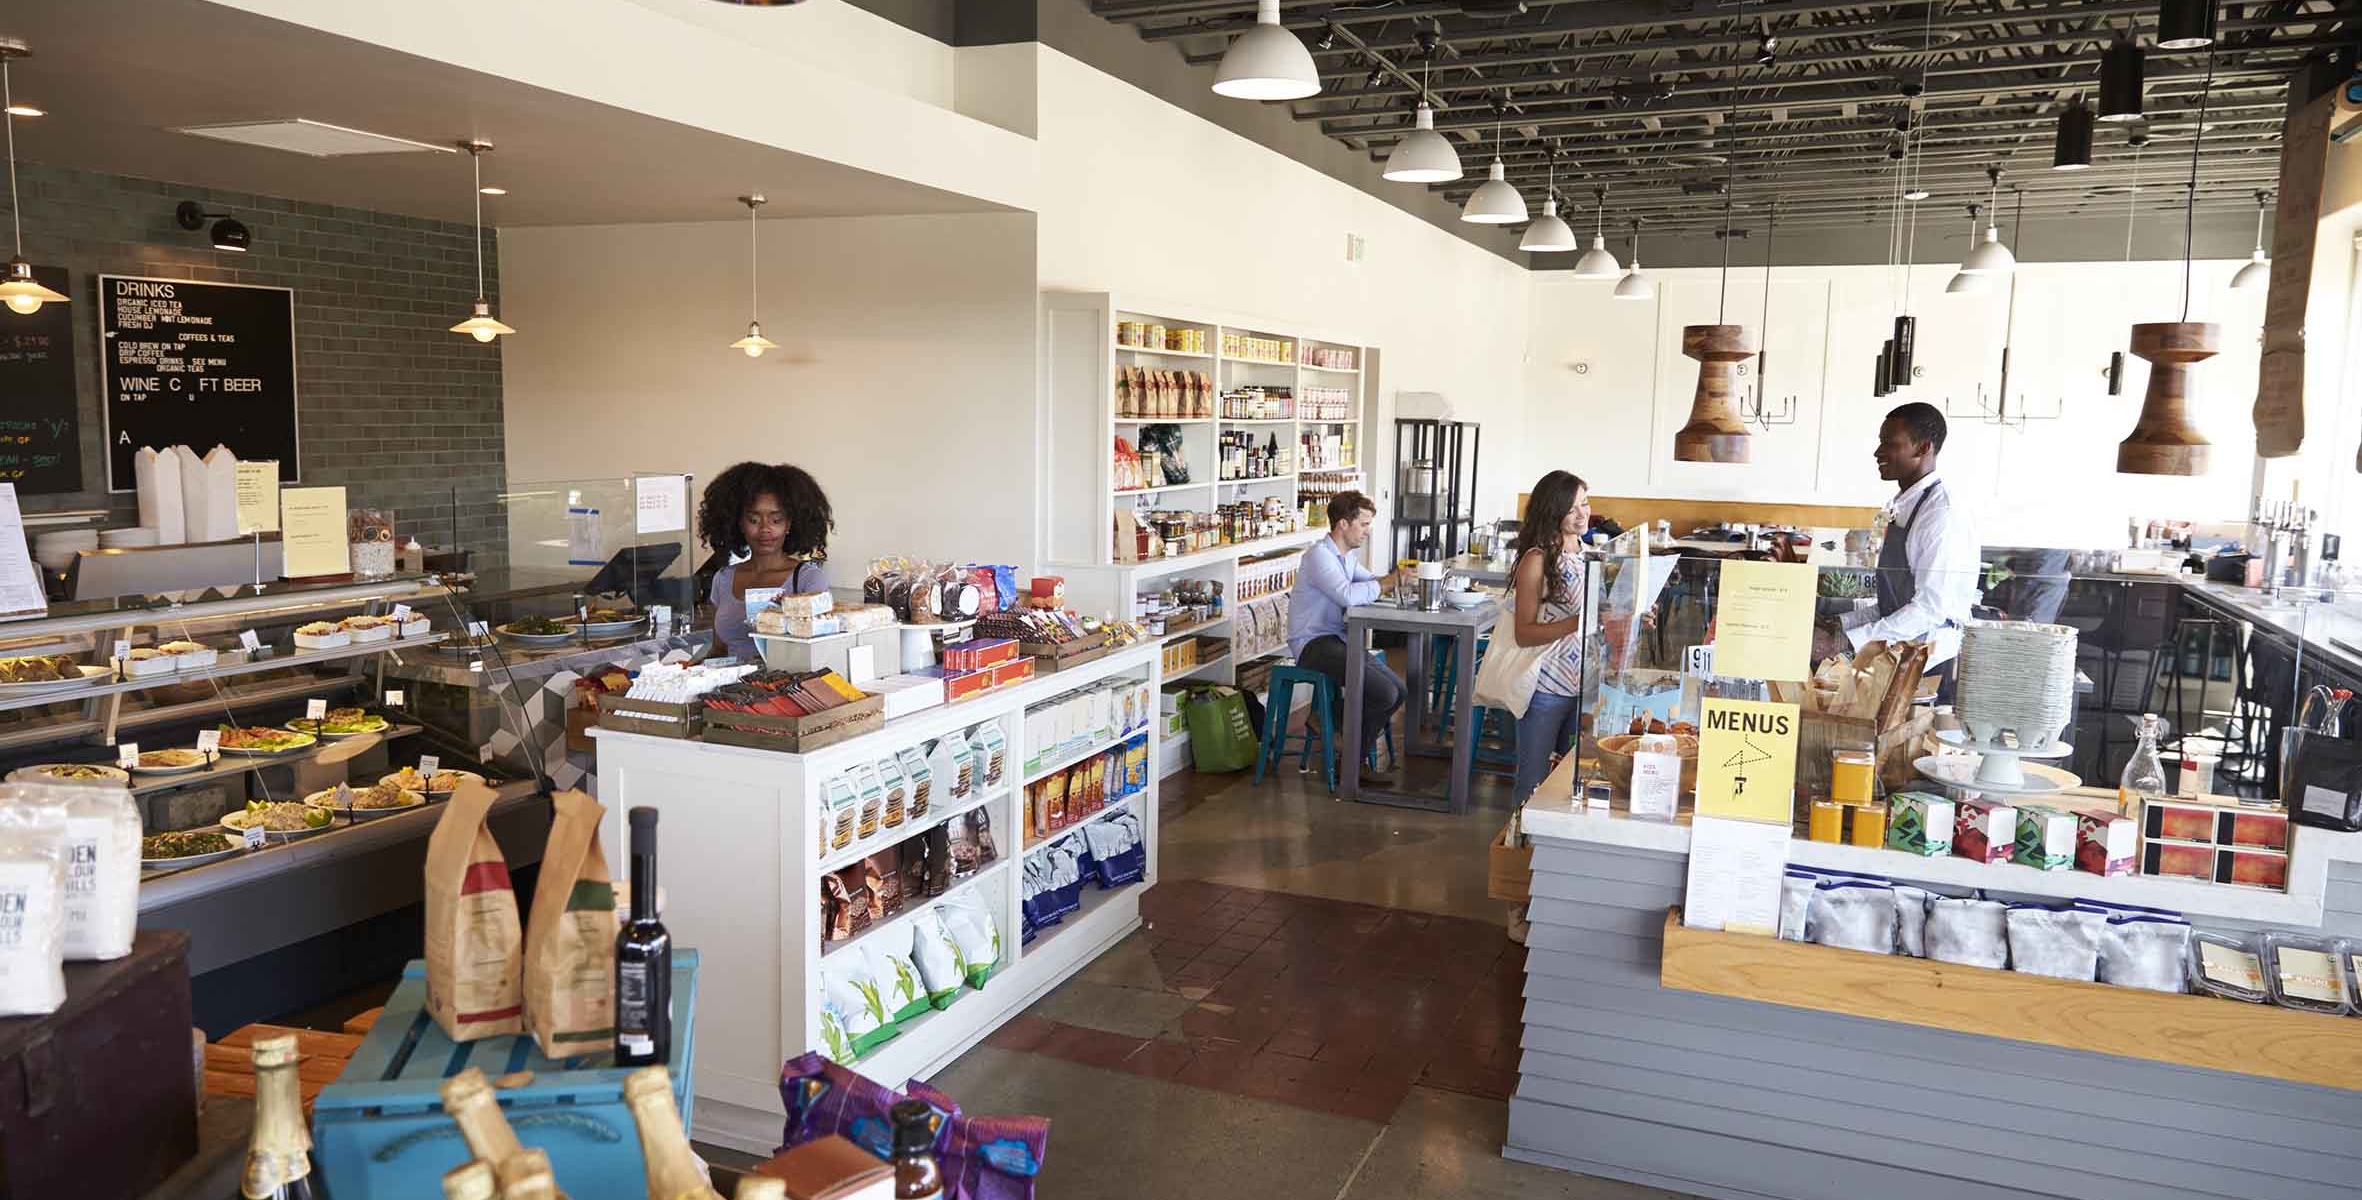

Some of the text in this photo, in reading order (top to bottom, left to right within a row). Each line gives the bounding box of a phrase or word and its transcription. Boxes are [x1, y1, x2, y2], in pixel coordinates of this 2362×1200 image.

[116, 281, 175, 299] DRINKS
[117, 298, 183, 309] ORGANIC ICED TEA
[117, 306, 182, 316] HOUSE LEMONADE
[118, 313, 157, 322] CUCUMBER
[177, 316, 213, 325] LEMONADE
[118, 321, 141, 329] FRESH
[178, 333, 235, 343] COFFEES & TEAS
[118, 341, 138, 349] COLD
[140, 342, 159, 350] BREW
[173, 343, 186, 351] TAP
[119, 349, 165, 358] DRIP COFFEE
[119, 356, 227, 366] ESPRESSO DRINKS SEE MENU
[156, 364, 205, 373] ORGANIC TEAS
[120, 377, 160, 392] WINE
[223, 378, 262, 392] BEER
[120, 393, 131, 402] ON
[133, 393, 148, 401] TAP
[119, 430, 131, 444] A
[1707, 709, 1790, 736] MENUS
